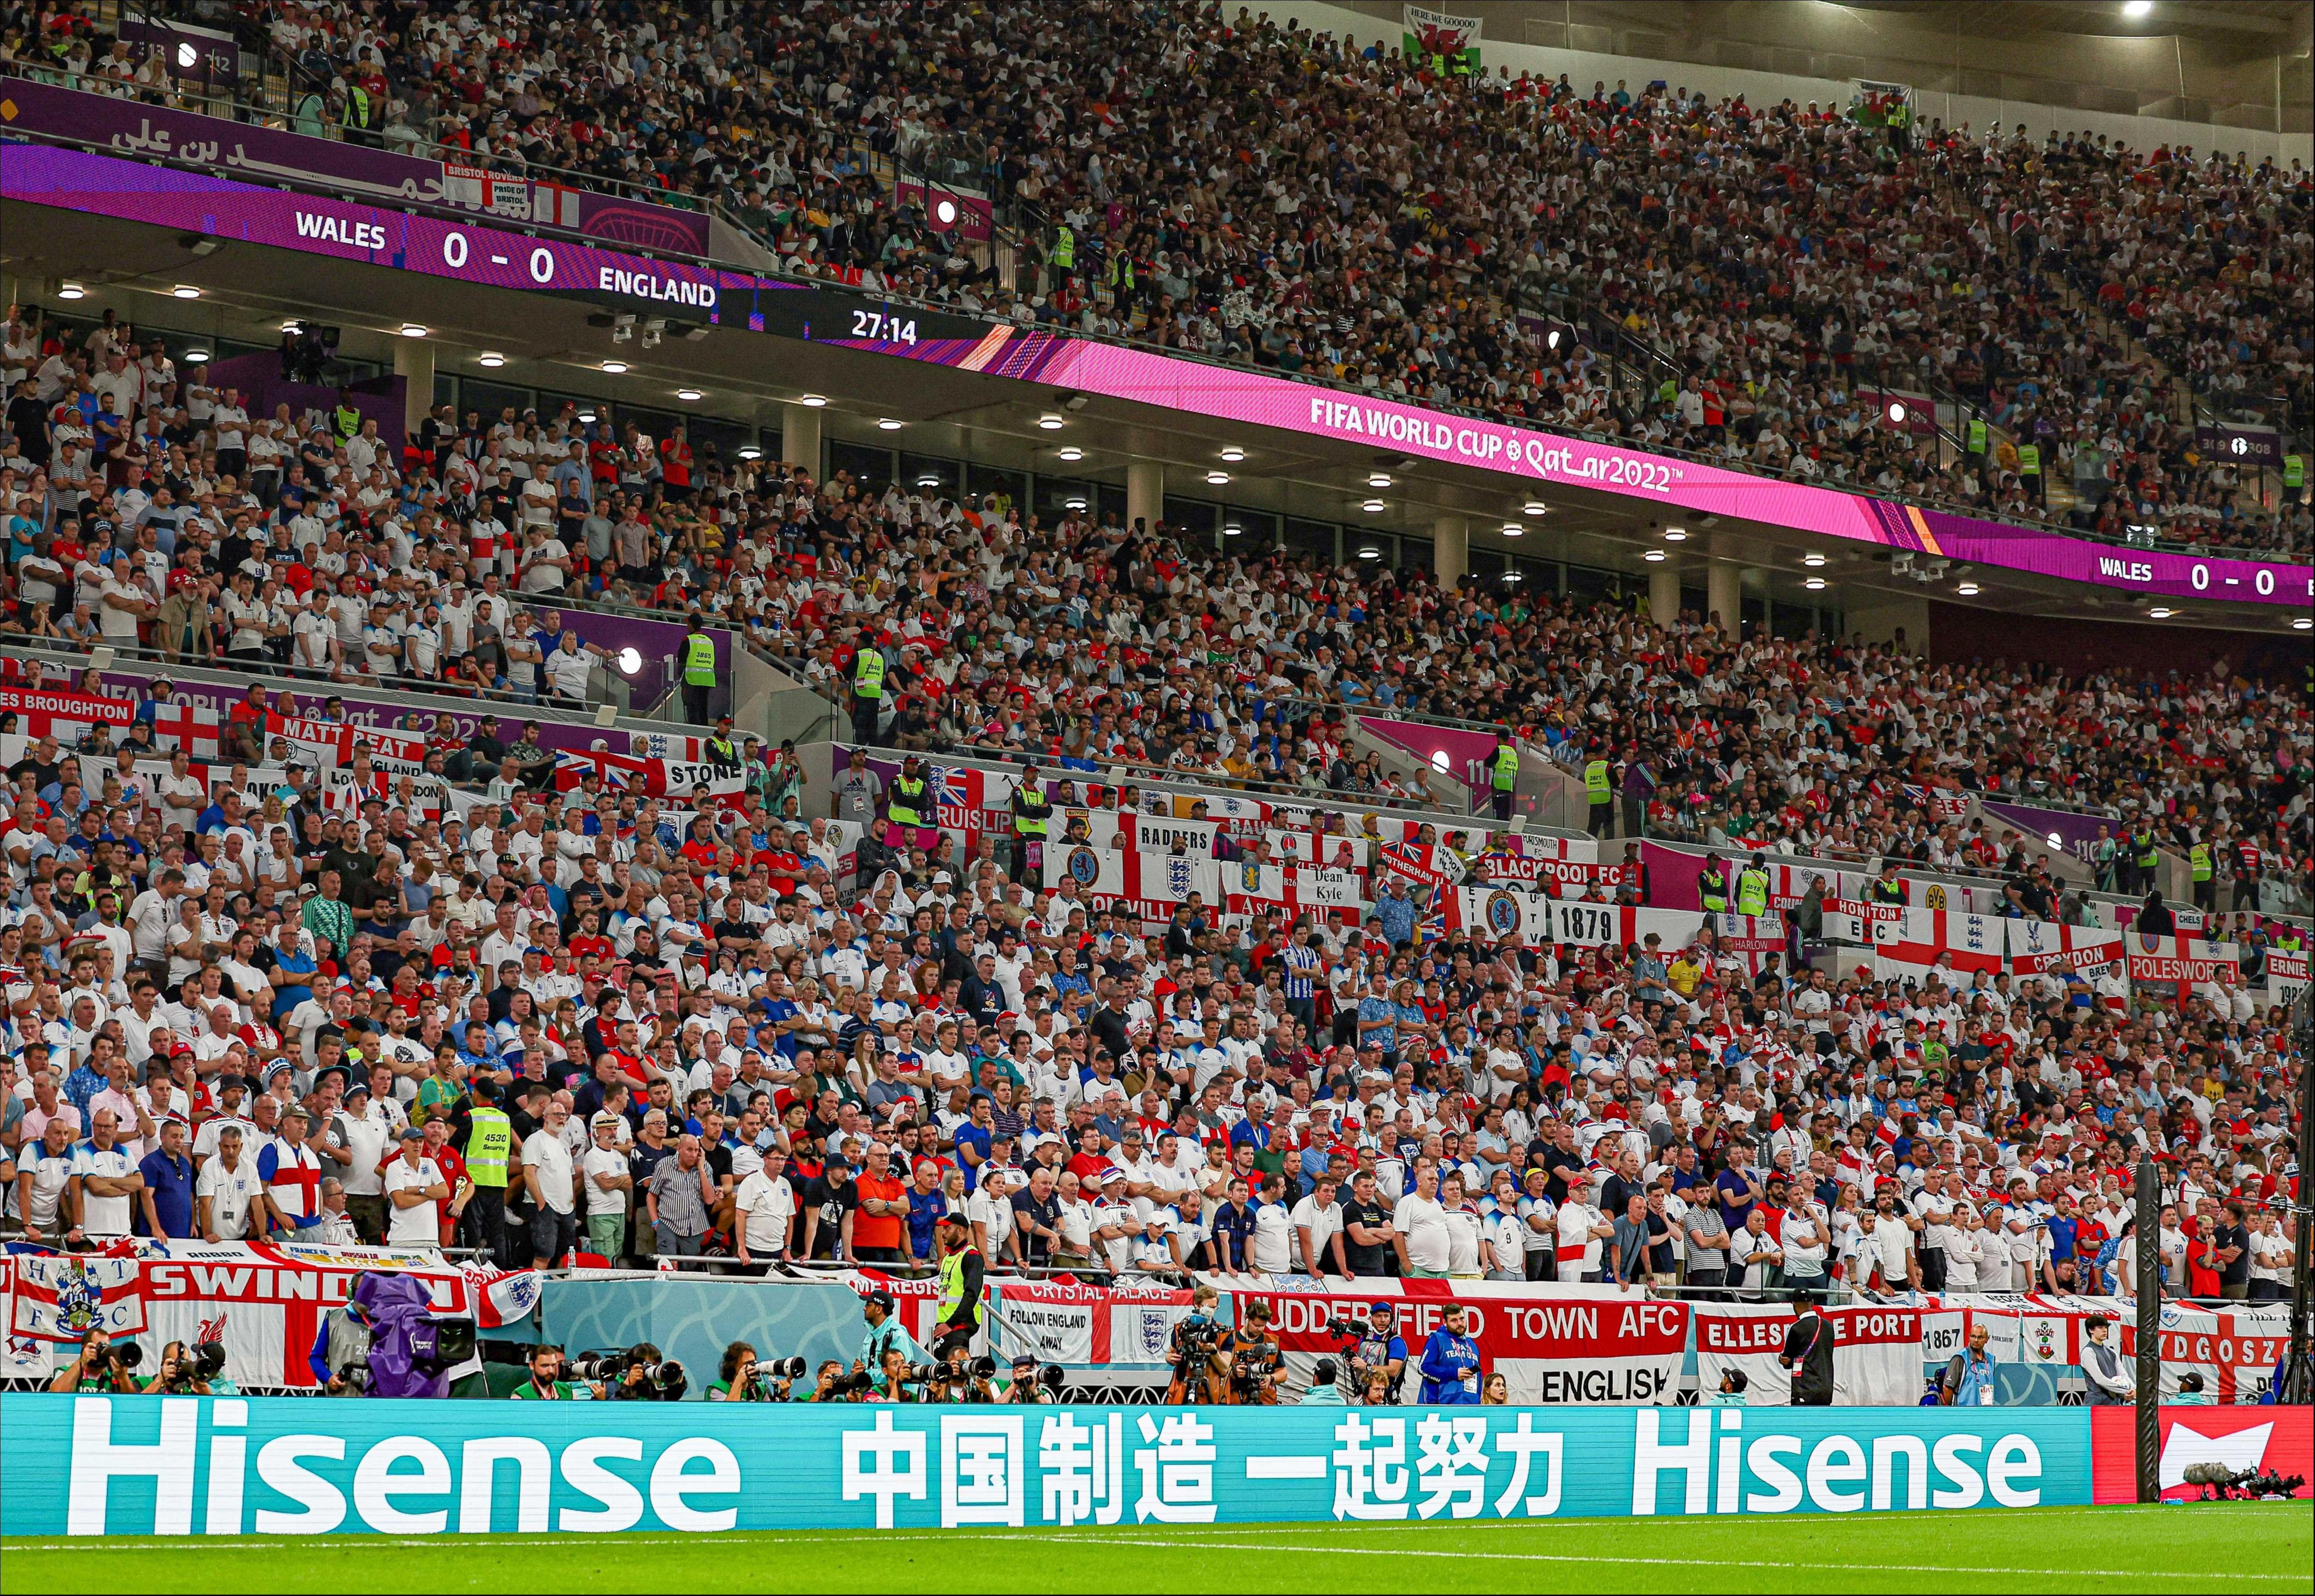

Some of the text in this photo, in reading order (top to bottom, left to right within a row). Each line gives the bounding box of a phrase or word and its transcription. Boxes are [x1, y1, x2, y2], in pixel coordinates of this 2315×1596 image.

[1411, 7, 1429, 20] HERE
[1432, 13, 1443, 23] WE
[448, 167, 524, 182] BRISTOL ROVERS
[494, 185, 515, 194] PRIDE
[496, 196, 524, 205] BRISTOL
[295, 211, 386, 251] WALES
[443, 231, 468, 268] 0
[530, 248, 554, 283] 0
[600, 267, 716, 308] ENGLAND
[852, 311, 916, 345] 27:14
[1310, 398, 1362, 433] FIFA
[1366, 409, 1453, 451] WORLD
[1457, 429, 1502, 460] CUP
[2099, 556, 2152, 582] WALES
[2191, 564, 2209, 591] 0
[2256, 570, 2275, 596] 0
[696, 651, 712, 660] 3865
[25, 695, 128, 720] BROUGHTON
[283, 719, 344, 744] MATT
[938, 807, 1012, 833] RUISLIP
[1315, 870, 1343, 883] Dean
[1382, 853, 1434, 883] ROTHERHAM
[1485, 859, 1621, 884] BLACKPOOL FC
[1284, 877, 1297, 888] B26
[1316, 885, 1342, 903] Kyle
[1487, 890, 1518, 911] ASTON VILLA
[1839, 901, 1896, 921] HONITON
[1561, 907, 1612, 942] 1879
[1761, 919, 1780, 930] THFC
[1735, 940, 1768, 950] HARLOW
[2270, 958, 2306, 977] ERNIE
[191, 1026, 200, 1037] 19
[482, 1143, 506, 1152] Security
[484, 1134, 507, 1143] 4530
[1506, 1232, 1512, 1244] 9
[2174, 1244, 2183, 1254] 20
[28, 1259, 127, 1281] H T
[150, 1265, 452, 1308] SWINDN
[1030, 1285, 1171, 1300] CRYSTAL PALACE
[1986, 1294, 2027, 1304] HEDGE
[29, 1306, 128, 1327] F C
[1010, 1309, 1086, 1329] FOLLOW ENGLAND
[1504, 1306, 1598, 1340] TOWN
[1617, 1305, 1680, 1338] AFC
[1856, 1314, 1915, 1337] PORT
[1039, 1336, 1062, 1350] AWAY
[1923, 1328, 1960, 1350] 1867
[67, 1397, 742, 1535] Hisense
[841, 1410, 1565, 1529] 中国制造 一起努力
[1632, 1409, 2042, 1515] Hisense
